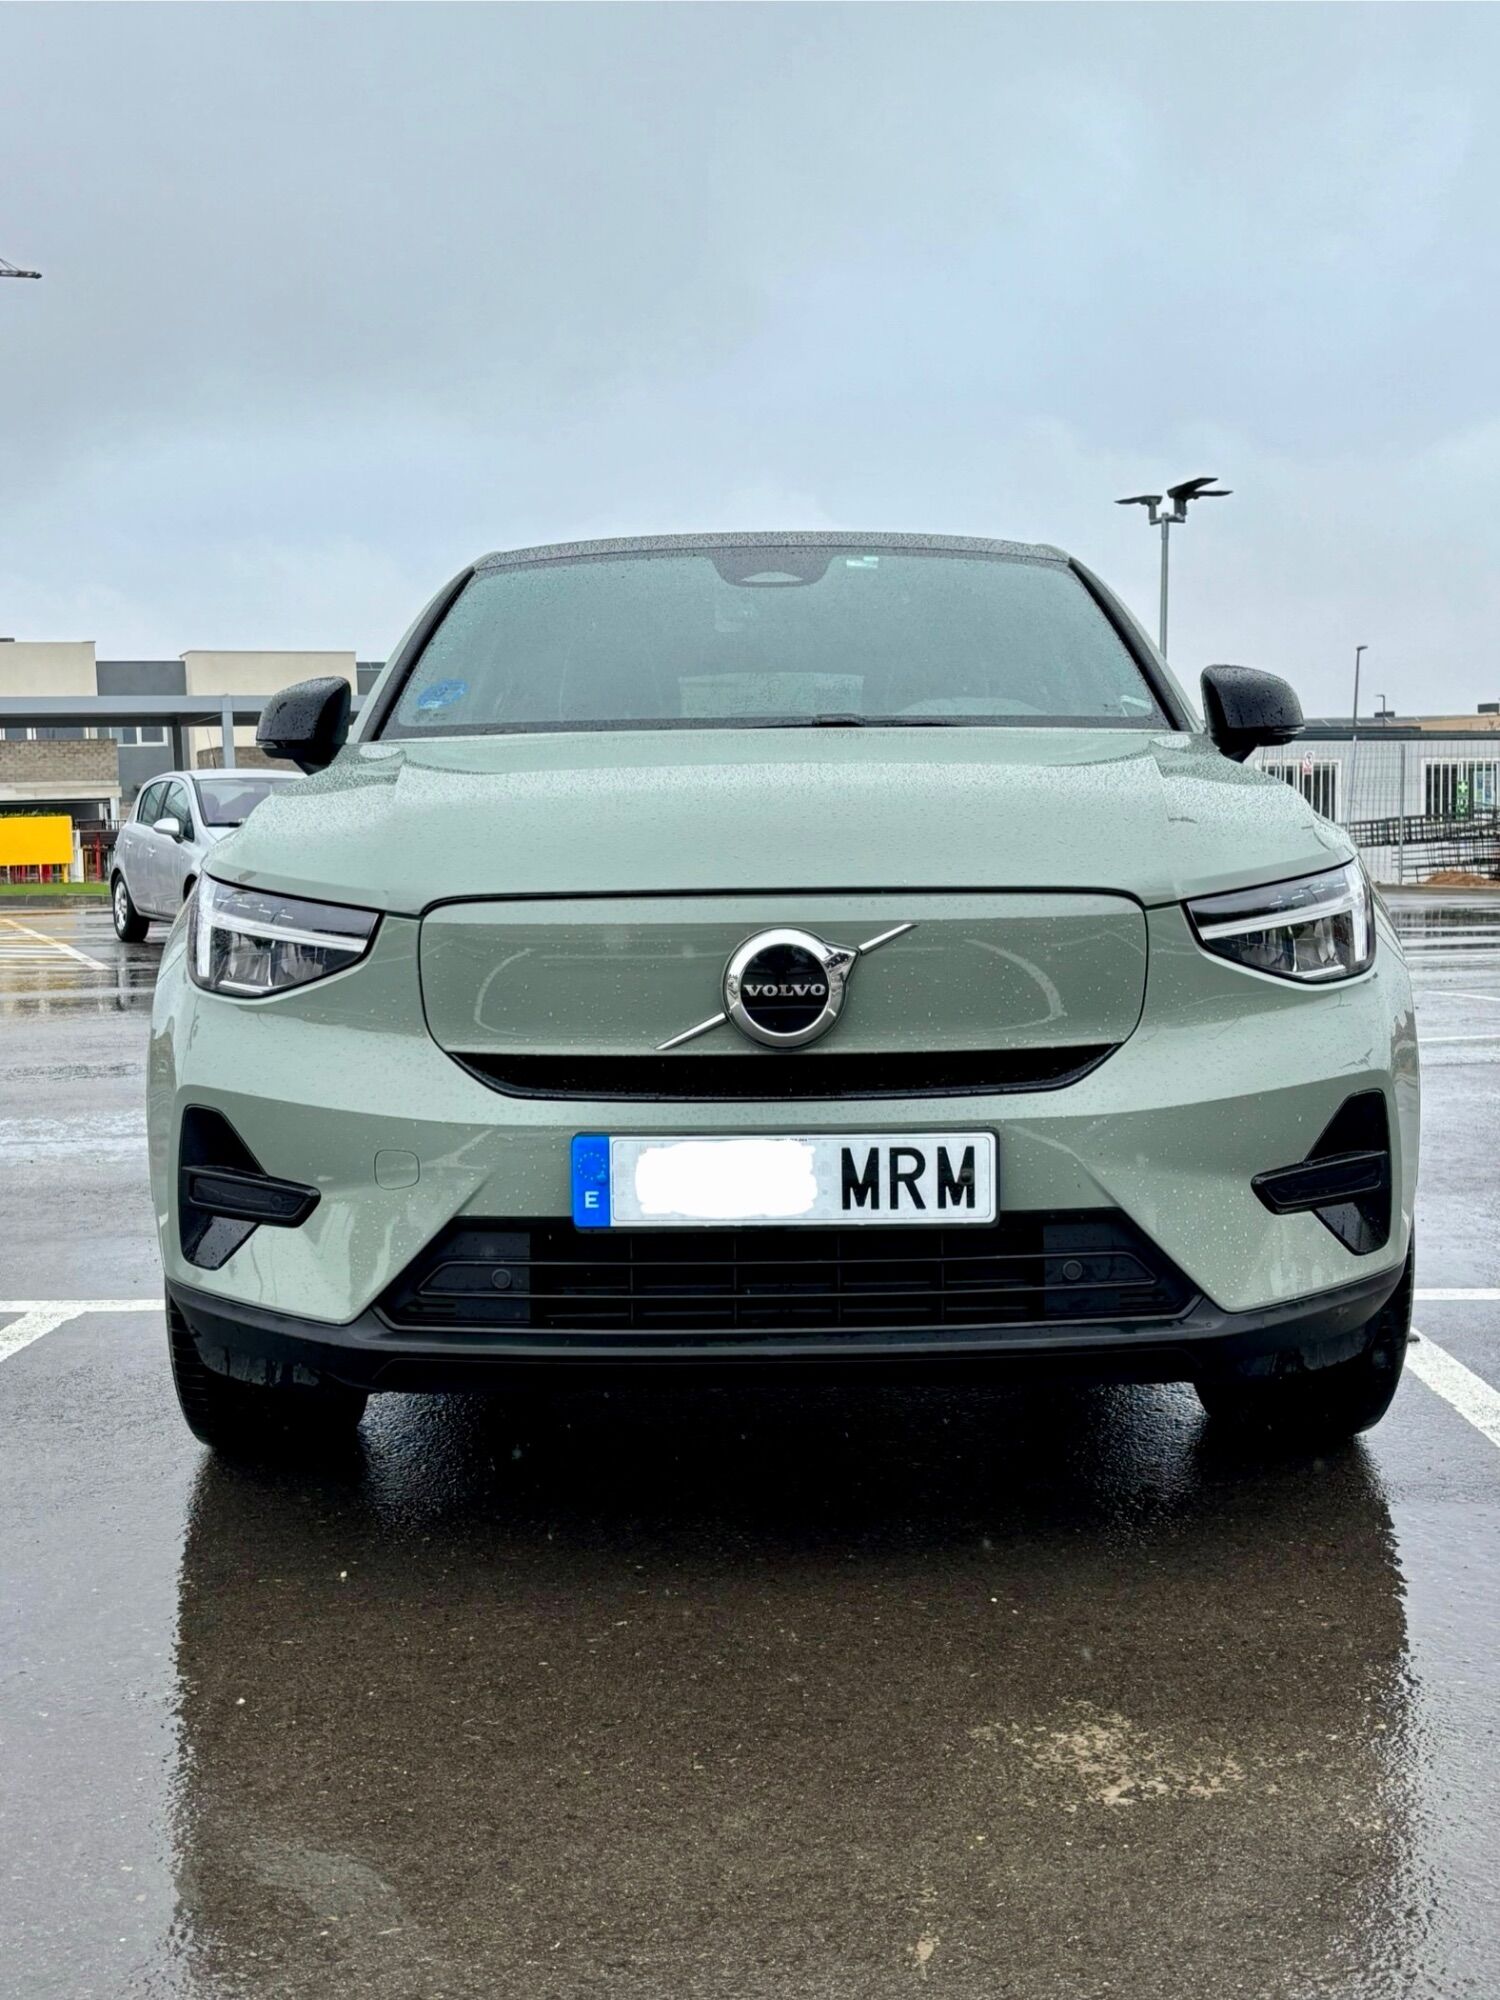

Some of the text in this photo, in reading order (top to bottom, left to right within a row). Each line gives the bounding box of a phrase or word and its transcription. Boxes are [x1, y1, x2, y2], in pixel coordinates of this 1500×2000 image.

[743, 983, 826, 997] VOLVO
[841, 1146, 976, 1210] MRM
[584, 1191, 600, 1208] E
